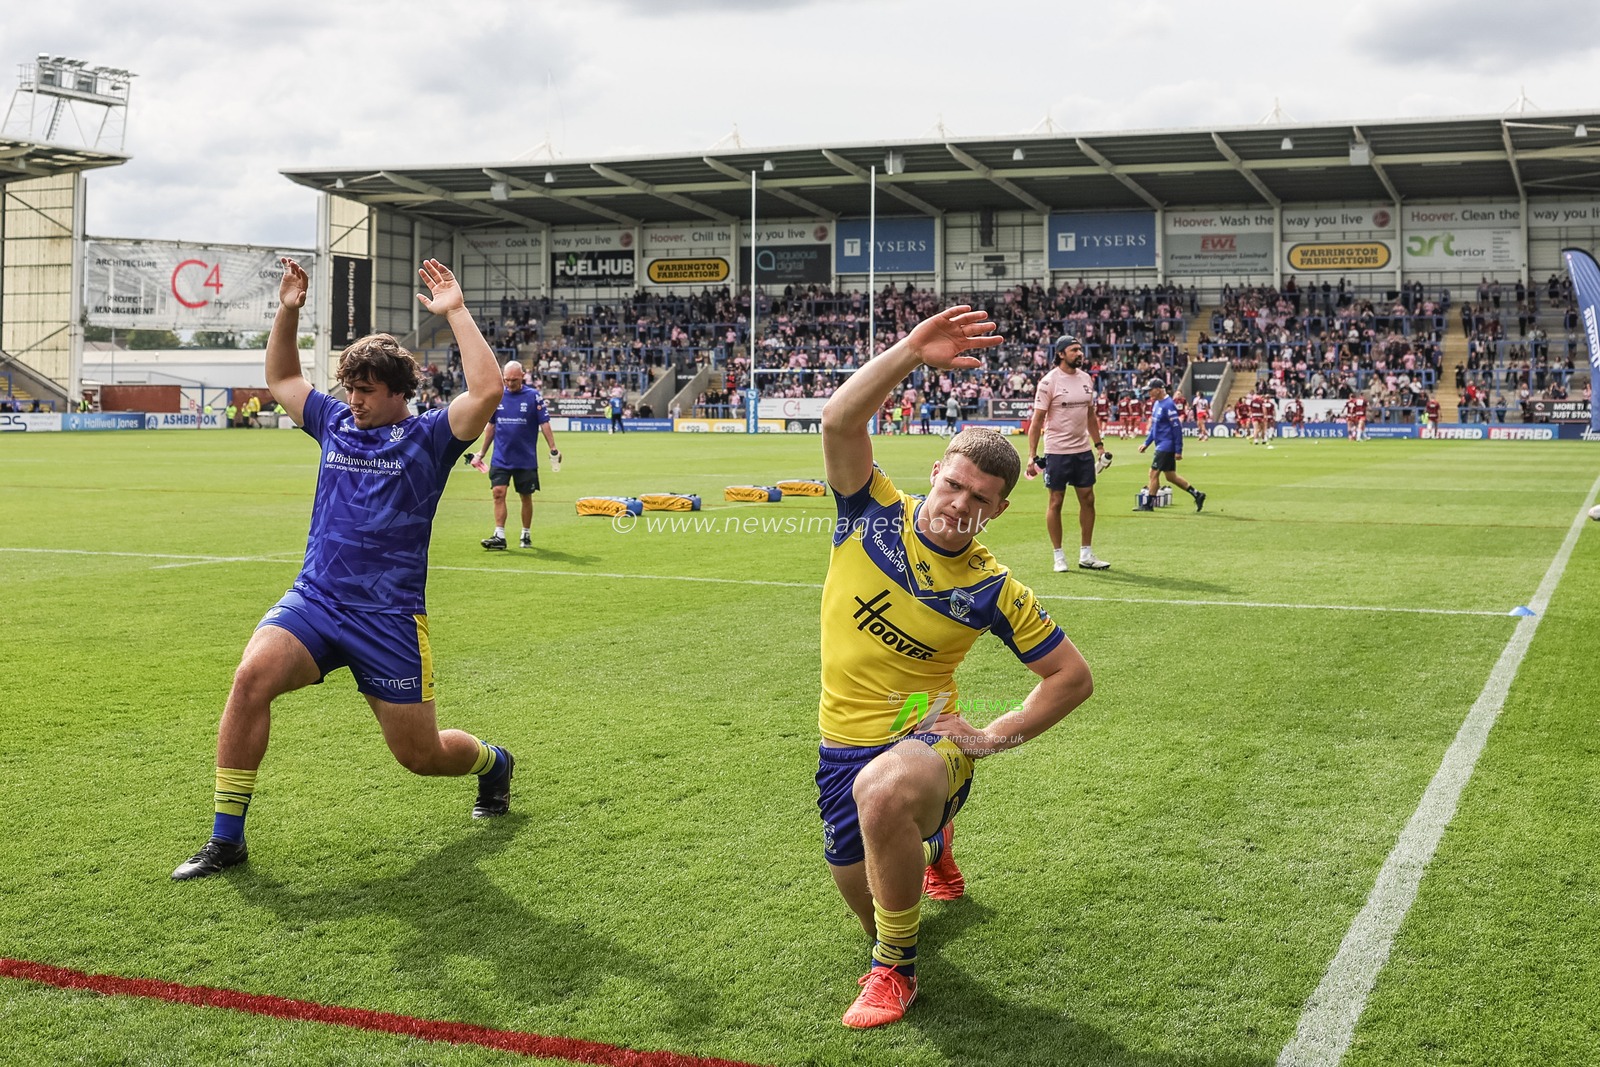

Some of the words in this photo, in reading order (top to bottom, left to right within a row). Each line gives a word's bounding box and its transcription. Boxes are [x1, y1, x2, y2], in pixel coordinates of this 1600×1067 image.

[1173, 216, 1217, 227] Hoover.
[1220, 215, 1250, 226] Wash
[1255, 214, 1274, 225] the
[1286, 217, 1309, 228] way
[1314, 216, 1336, 228] you
[1341, 213, 1363, 224] live
[1411, 211, 1457, 222] Hoover.
[1461, 209, 1495, 221] Clean
[1499, 208, 1520, 220] the
[1533, 210, 1559, 222] way
[1563, 209, 1586, 222] you
[692, 231, 714, 242] Chill
[765, 230, 784, 240] you
[788, 228, 806, 238] live
[505, 237, 527, 247] Cook
[531, 237, 541, 247] th
[553, 238, 571, 248] way
[574, 237, 591, 247] you
[595, 234, 611, 244] live
[1081, 234, 1147, 248] TYSERS
[1201, 238, 1236, 250] EWL
[1194, 253, 1238, 262] Warrington
[1300, 248, 1379, 257] WARRINGTON
[95, 258, 157, 268] ARCHITECTURE
[1300, 256, 1379, 265] FABRICATIONS
[555, 258, 634, 276] FUELHUB
[657, 263, 720, 271] WARRINGTON
[657, 270, 720, 279] FABRICATIONS
[171, 258, 224, 308] C4
[107, 295, 143, 304] PROJECT
[214, 299, 250, 312] Projects
[94, 306, 155, 315] MANAGEMENT
[163, 415, 217, 426] ASHBROOK
[1552, 411, 1570, 419] JUST
[84, 417, 116, 429] Halliwell
[117, 418, 138, 429] Jones
[1489, 429, 1553, 440] BETFRED
[334, 453, 377, 468] Birchwood
[377, 458, 402, 469] Park
[872, 531, 907, 573] Resulting
[853, 589, 939, 661] HOOVER
